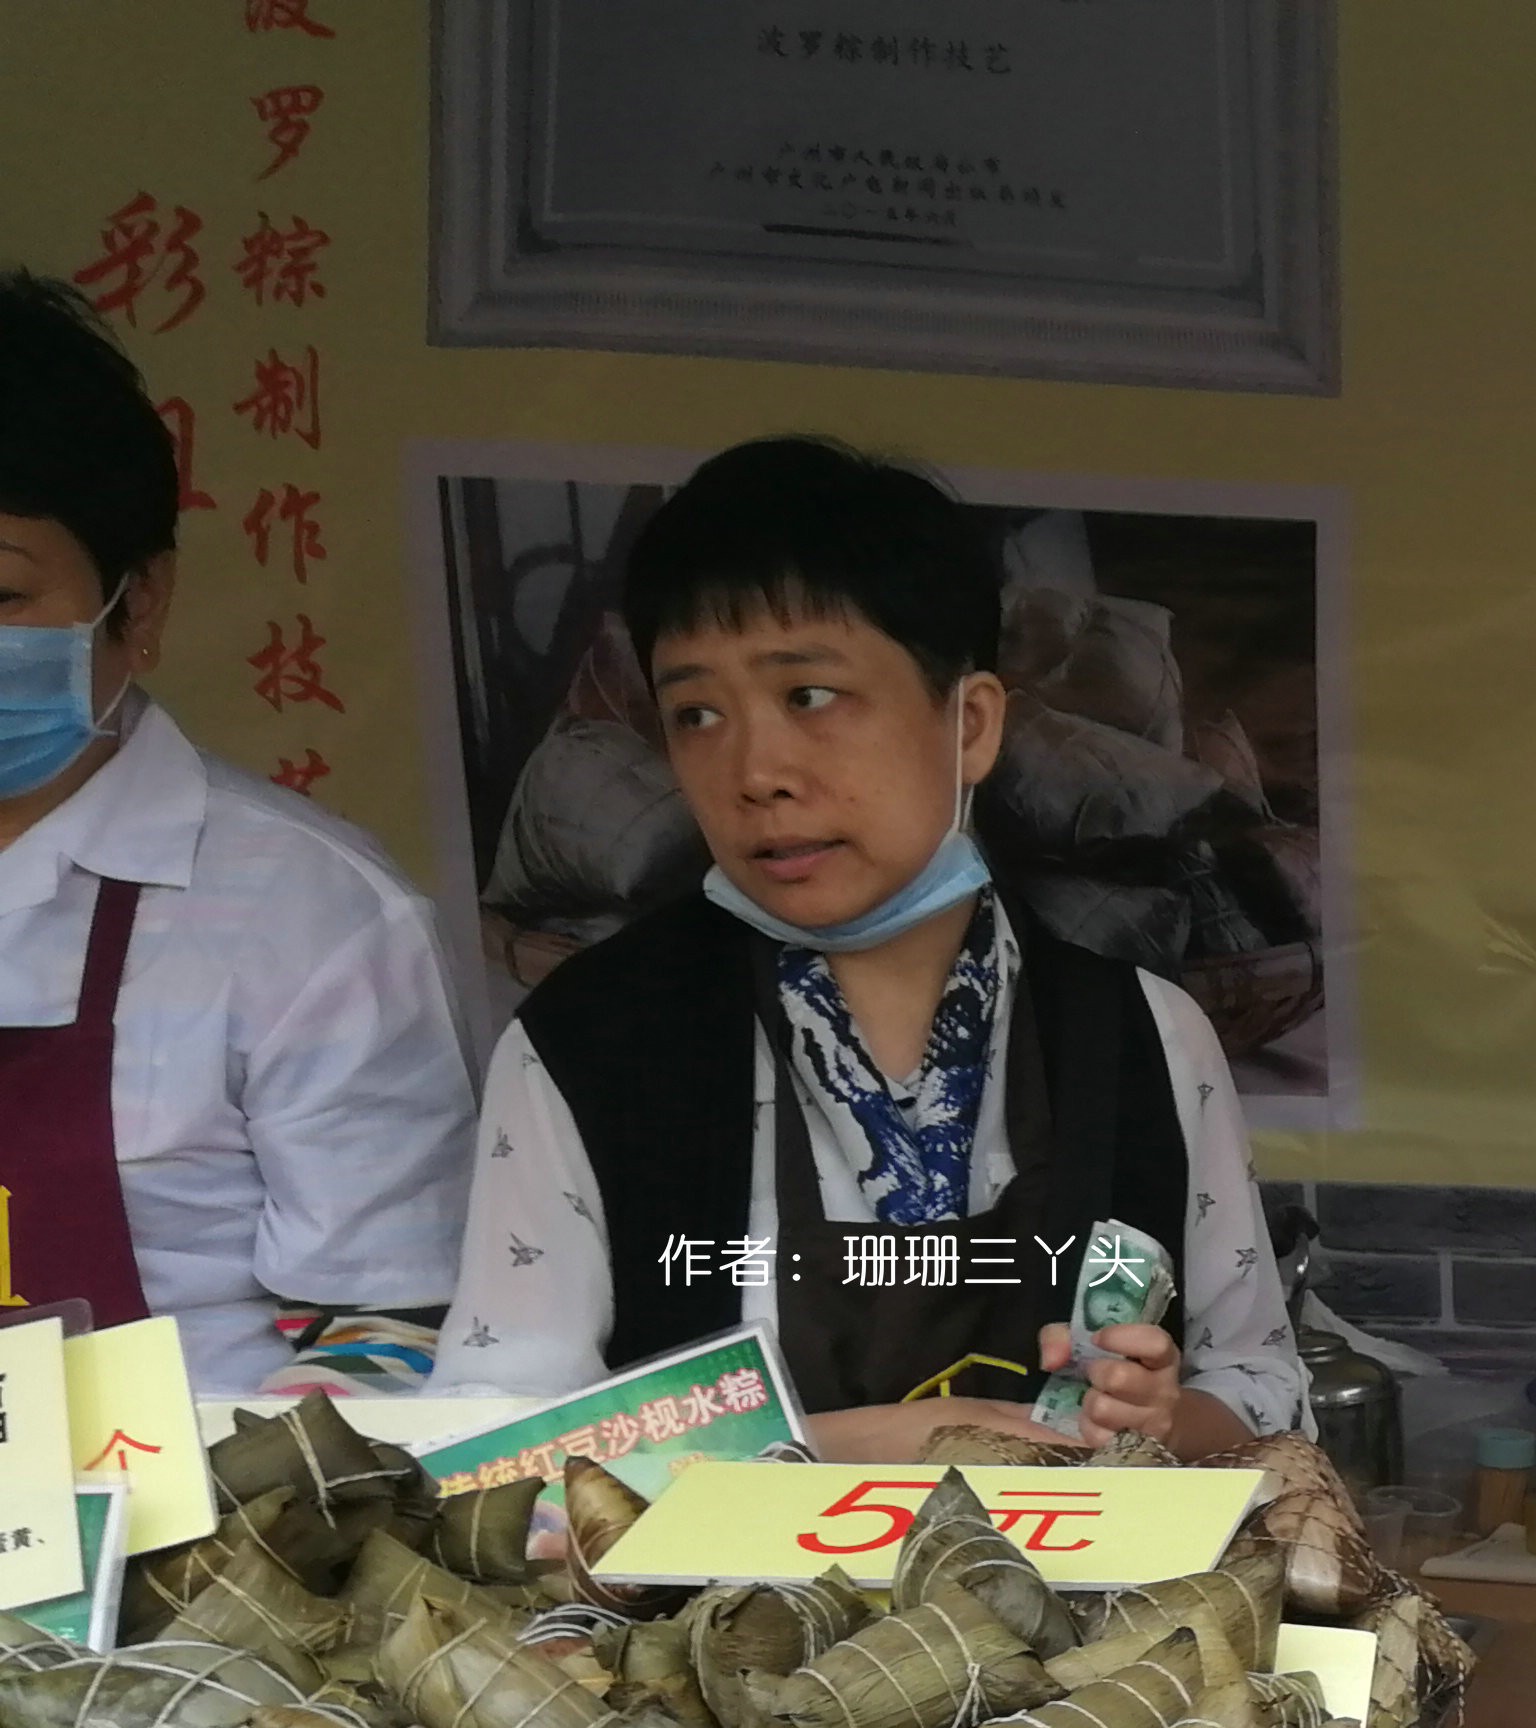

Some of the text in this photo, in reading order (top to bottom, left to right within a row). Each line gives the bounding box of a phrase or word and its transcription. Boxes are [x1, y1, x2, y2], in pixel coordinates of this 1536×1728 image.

[756, 24, 1012, 76] 波罗粽制作技艺
[796, 1480, 1103, 1555] 5元
